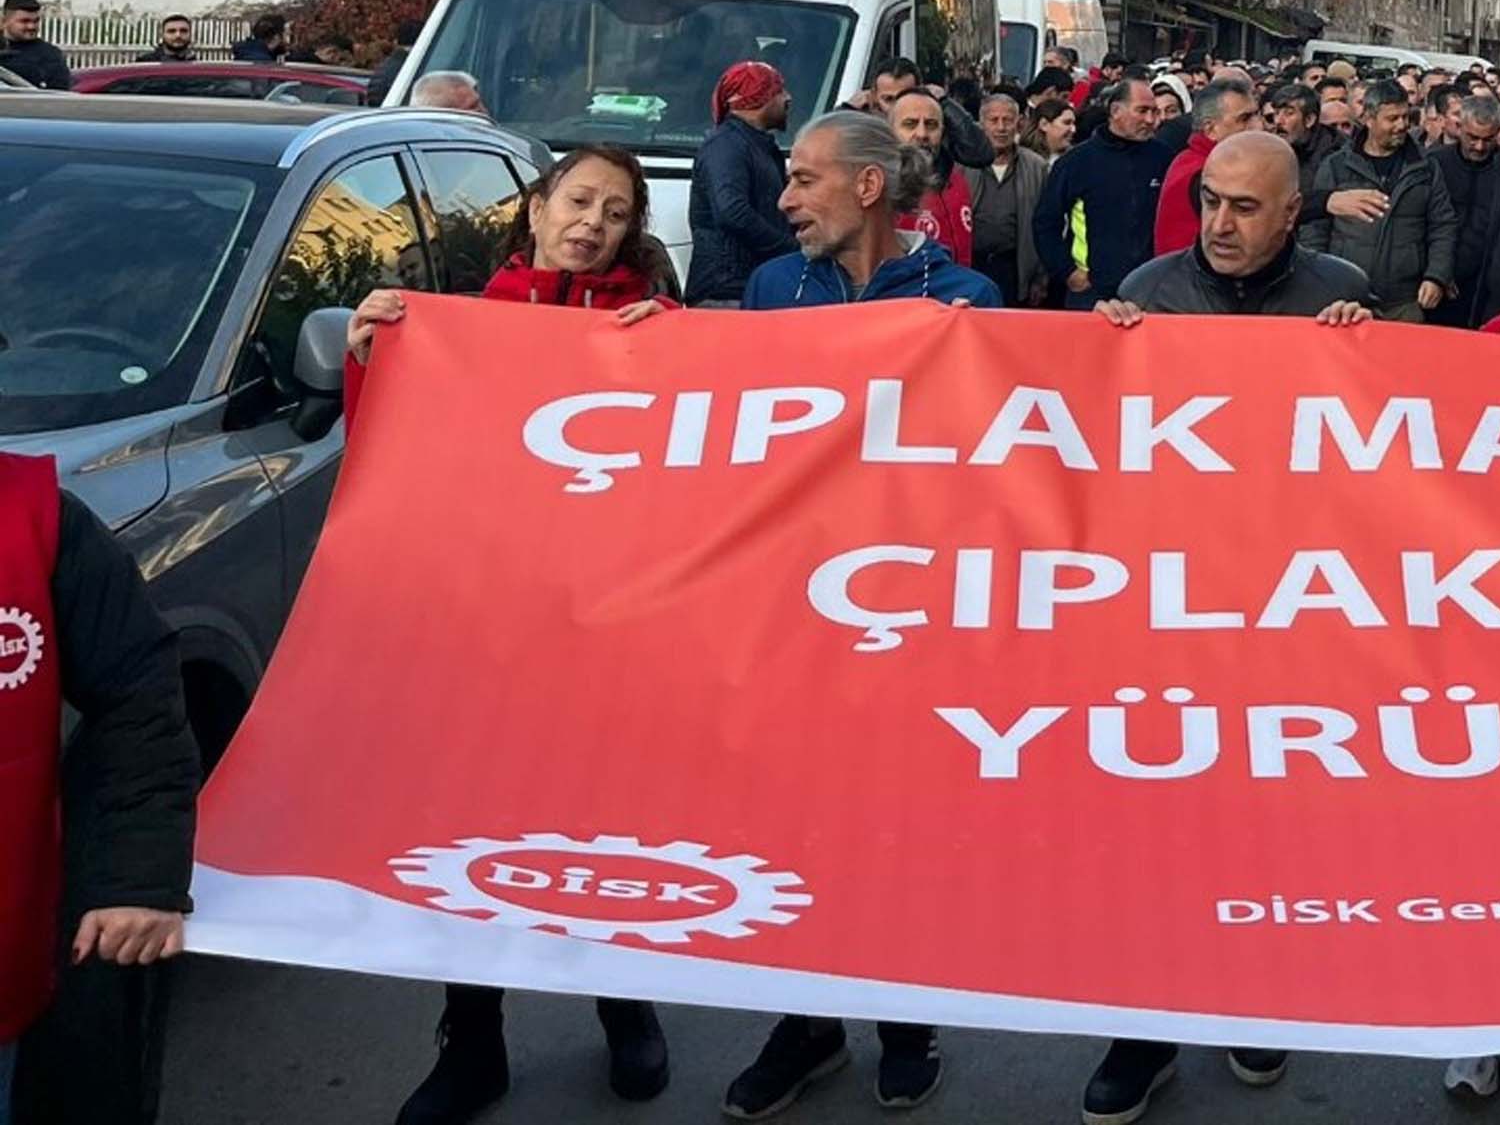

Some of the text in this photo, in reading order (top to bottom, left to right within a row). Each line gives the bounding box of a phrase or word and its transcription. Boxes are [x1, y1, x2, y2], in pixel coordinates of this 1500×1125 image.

[523, 379, 1236, 493] ÇIPLAK
[484, 862, 719, 905] DİSK
[1216, 895, 1382, 924] DİSK
